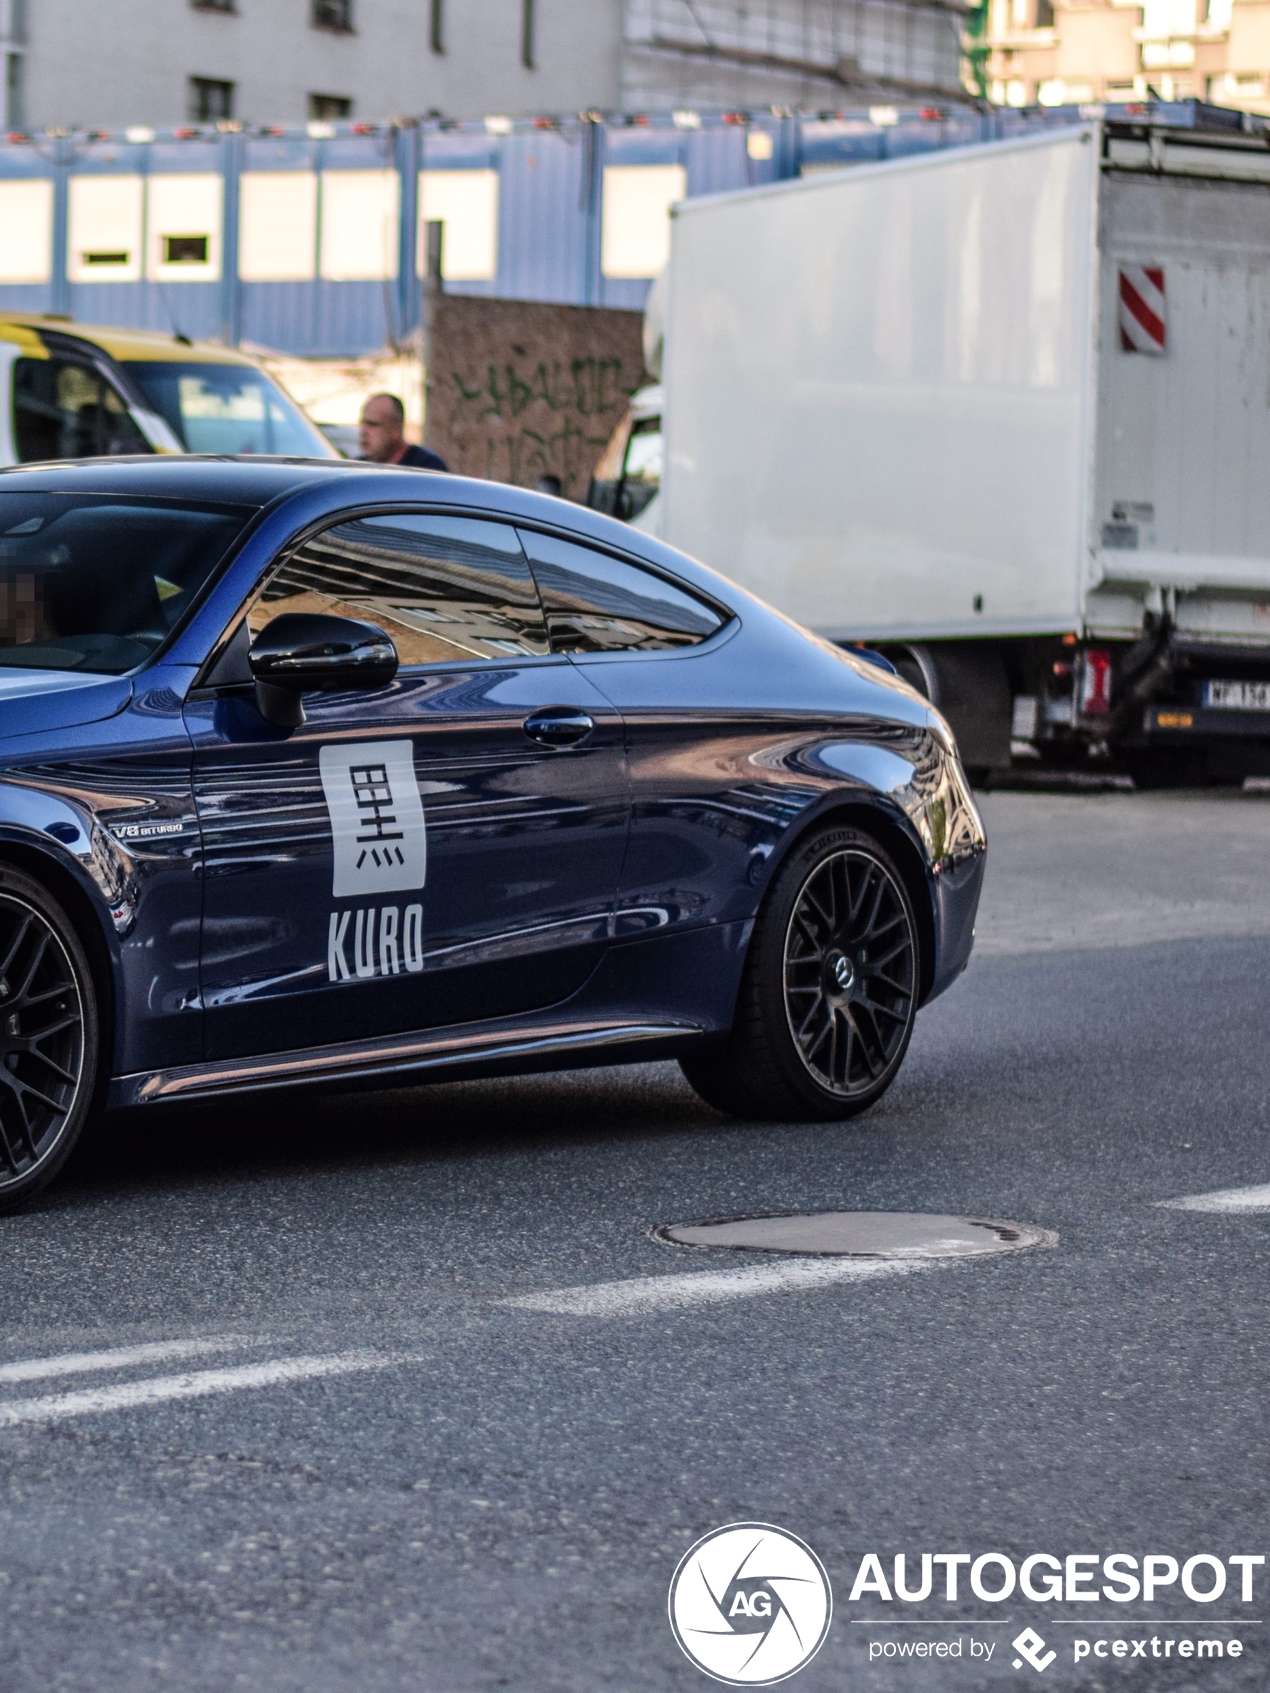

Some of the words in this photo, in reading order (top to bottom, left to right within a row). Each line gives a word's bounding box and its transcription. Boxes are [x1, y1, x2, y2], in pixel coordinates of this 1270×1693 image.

[112, 825, 139, 838] V8
[140, 823, 183, 836] BITURBO
[327, 903, 423, 982] KURO
